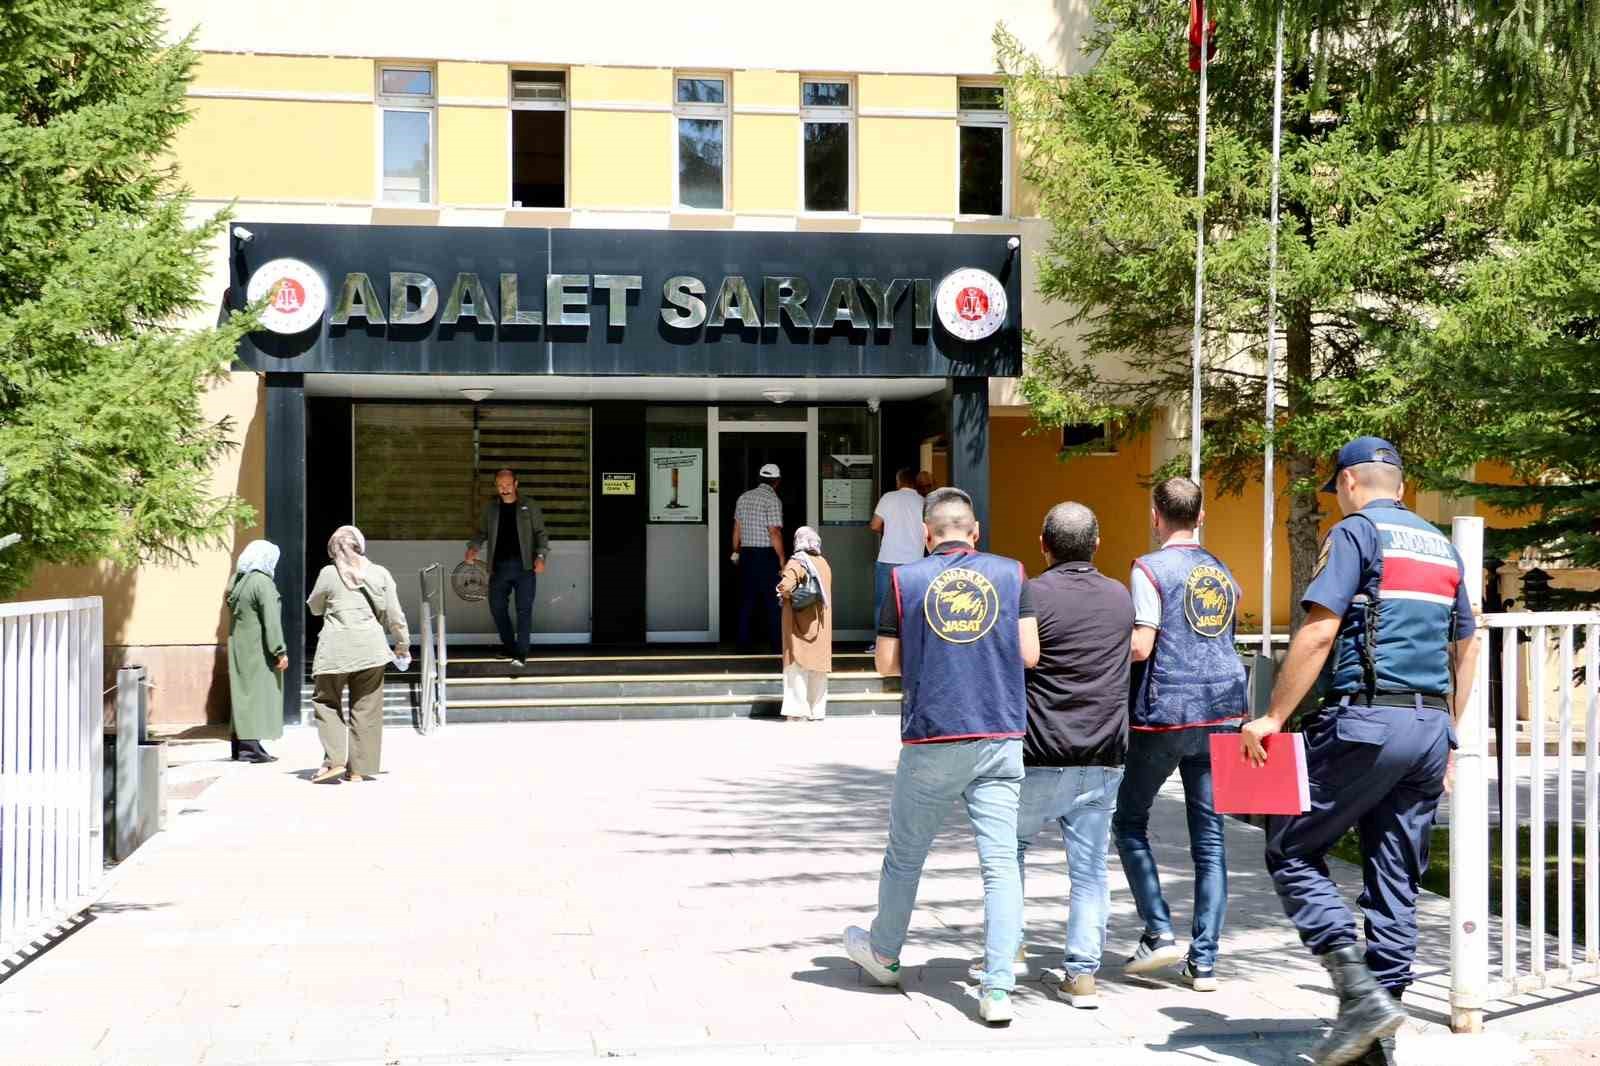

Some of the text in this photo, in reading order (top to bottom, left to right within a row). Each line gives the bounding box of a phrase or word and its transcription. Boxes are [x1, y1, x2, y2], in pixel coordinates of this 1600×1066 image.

[330, 272, 933, 329] ADALET SARAYI
[942, 620, 981, 632] JASAT
[1197, 616, 1224, 628] JASAT
